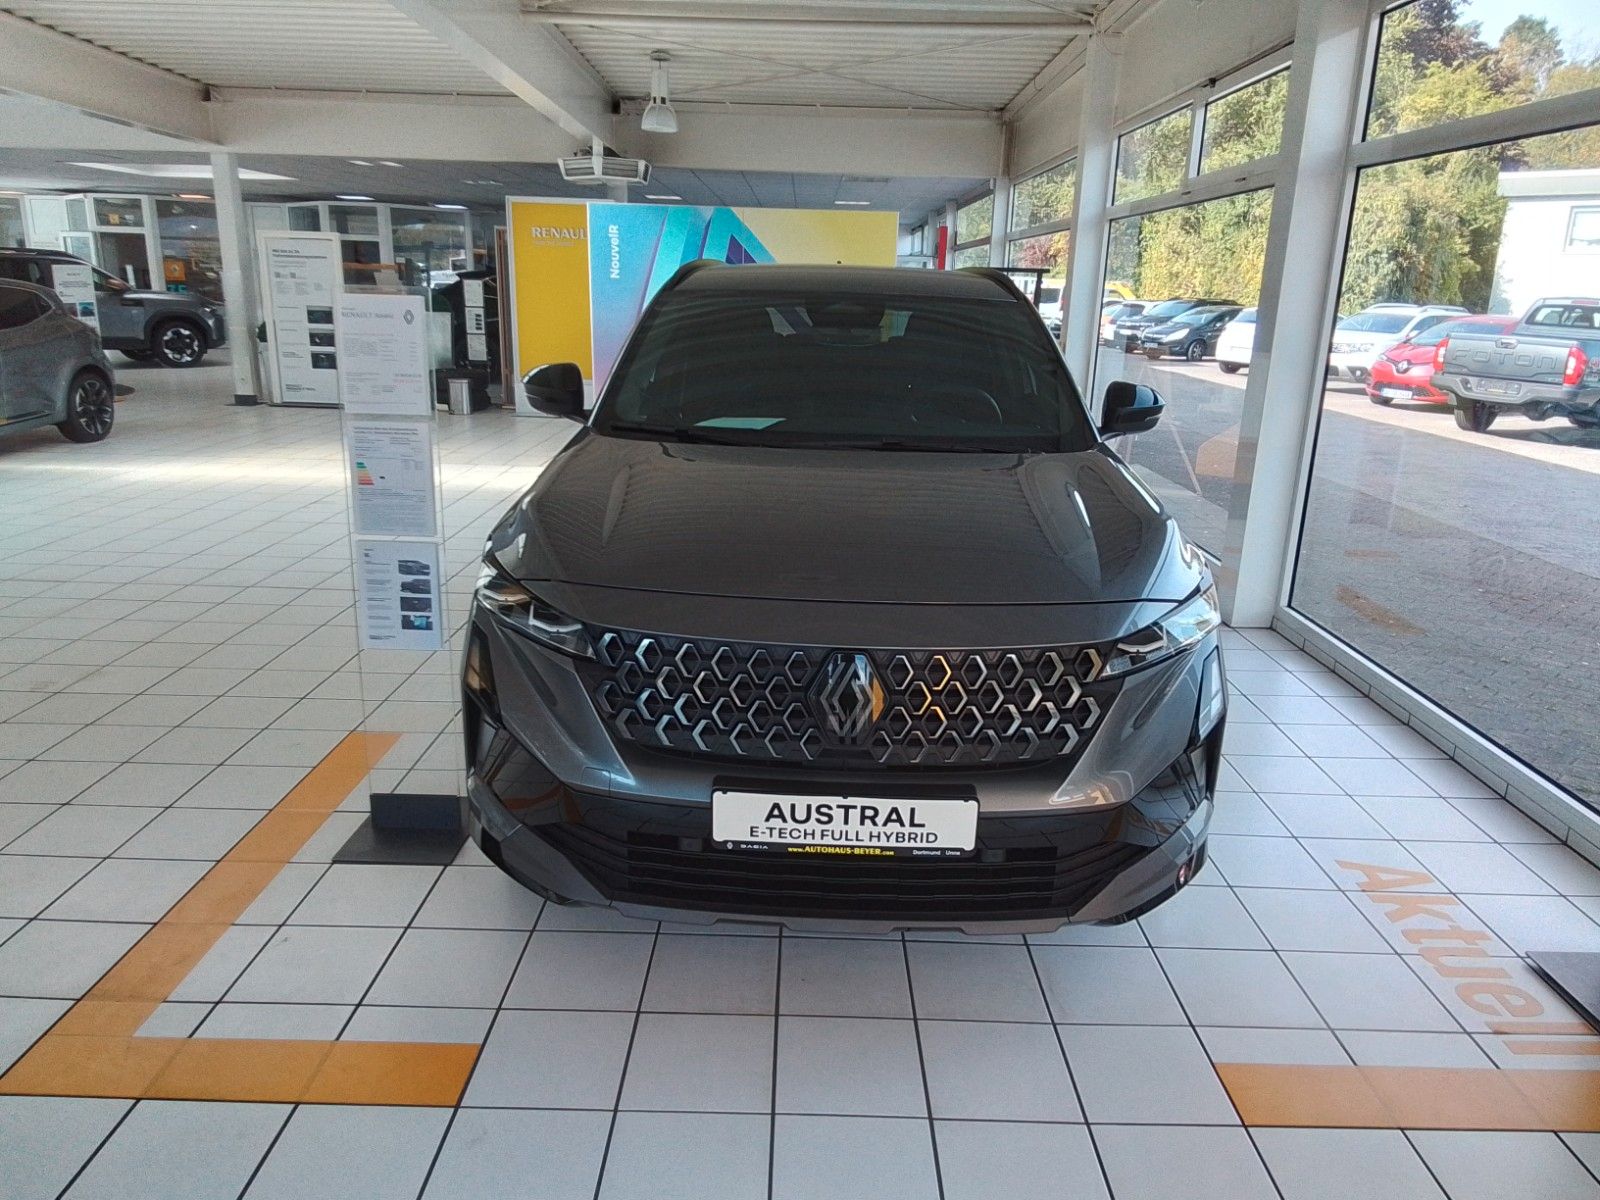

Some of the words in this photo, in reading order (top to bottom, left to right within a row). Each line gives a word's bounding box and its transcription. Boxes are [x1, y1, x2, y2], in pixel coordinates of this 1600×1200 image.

[532, 226, 588, 240] RENAUL
[1452, 349, 1559, 370] FOTON
[764, 802, 926, 828] AUSTRAL
[749, 826, 816, 840] E-TECH
[820, 829, 865, 842] FULL
[868, 831, 939, 844] HYBRID
[787, 845, 895, 856] www.AUTOHAUS-BEYER.com
[1334, 859, 1600, 1055] Aktuell
